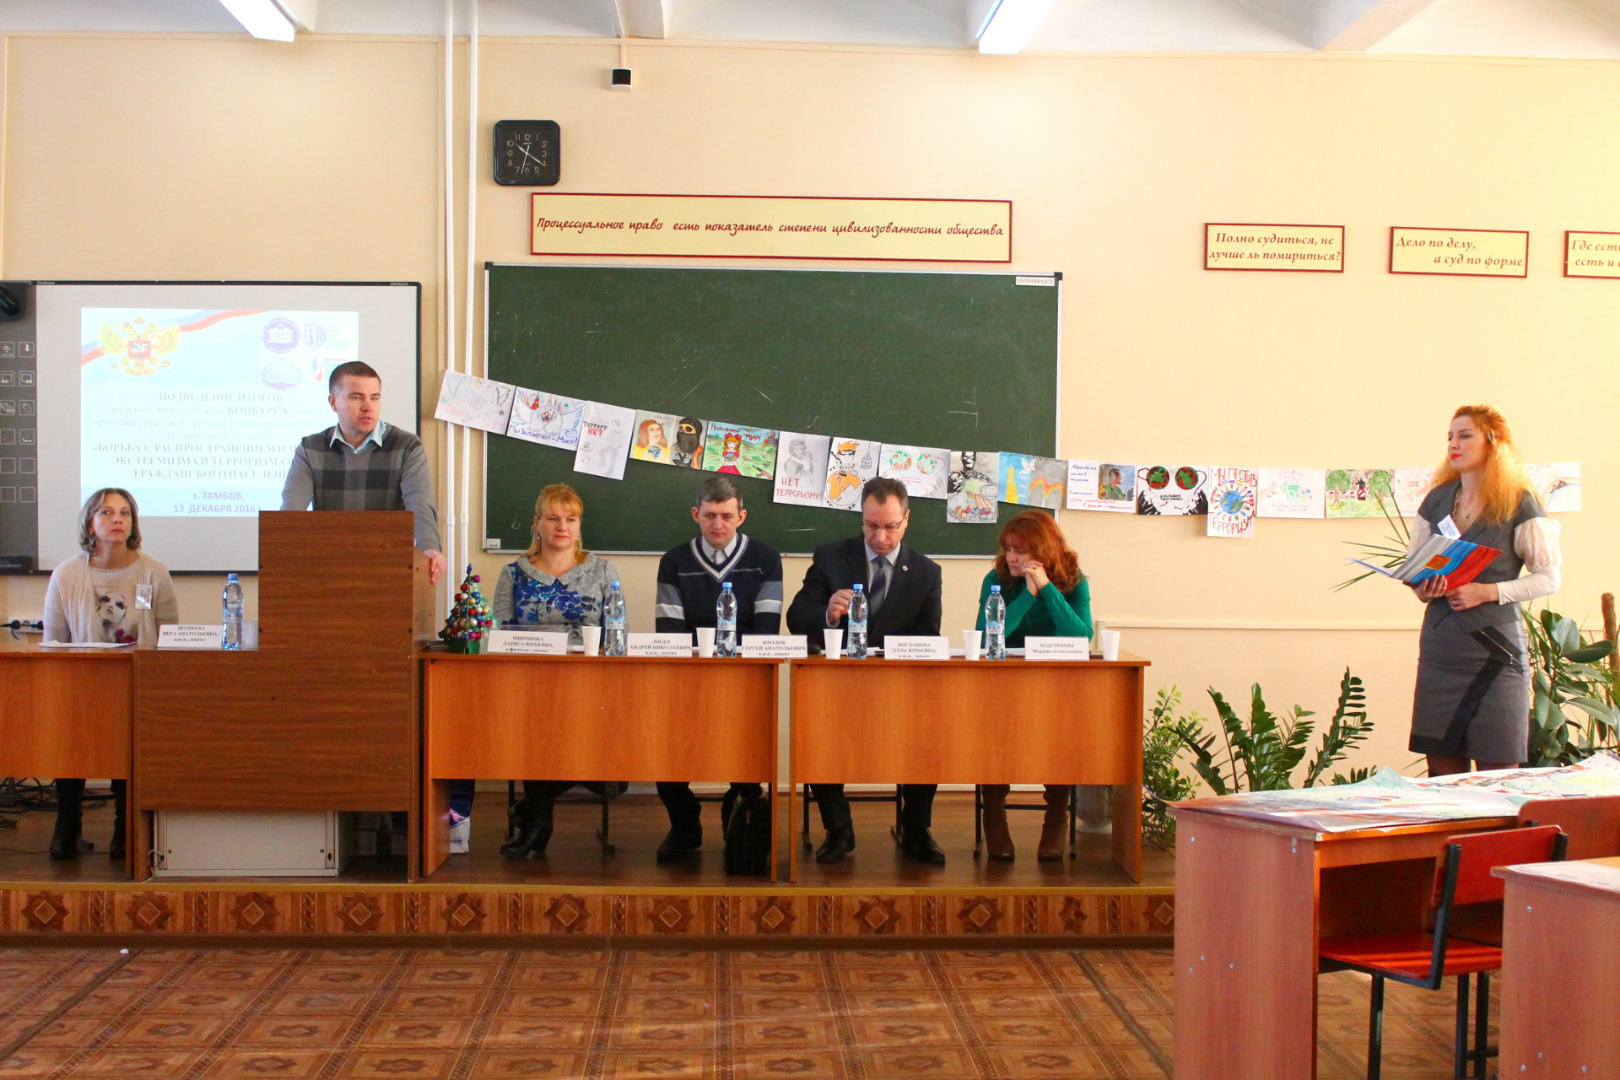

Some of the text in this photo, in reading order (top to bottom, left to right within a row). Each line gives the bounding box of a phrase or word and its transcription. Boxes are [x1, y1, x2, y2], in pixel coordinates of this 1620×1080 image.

[537, 218, 1004, 238] Процессуальное право есть показатель степени цивилизованности общества
[1216, 232, 1334, 247] Полно судиться, не
[1395, 236, 1476, 251] Дело по делу,
[1571, 240, 1592, 251] Где
[1208, 250, 1341, 264] лучше ль помириться?
[1433, 253, 1523, 269] а суд по форме
[1575, 257, 1604, 267] есть
[1607, 258, 1614, 266] и
[238, 392, 284, 402] ИТОГОВ
[228, 406, 288, 416] КОНКУРСА
[781, 476, 800, 488] НЕТ
[203, 492, 245, 502] ТАМБОВ,
[173, 504, 185, 513] 13
[188, 504, 232, 515] ДЕКАБРЯ
[234, 504, 256, 513] 2016
